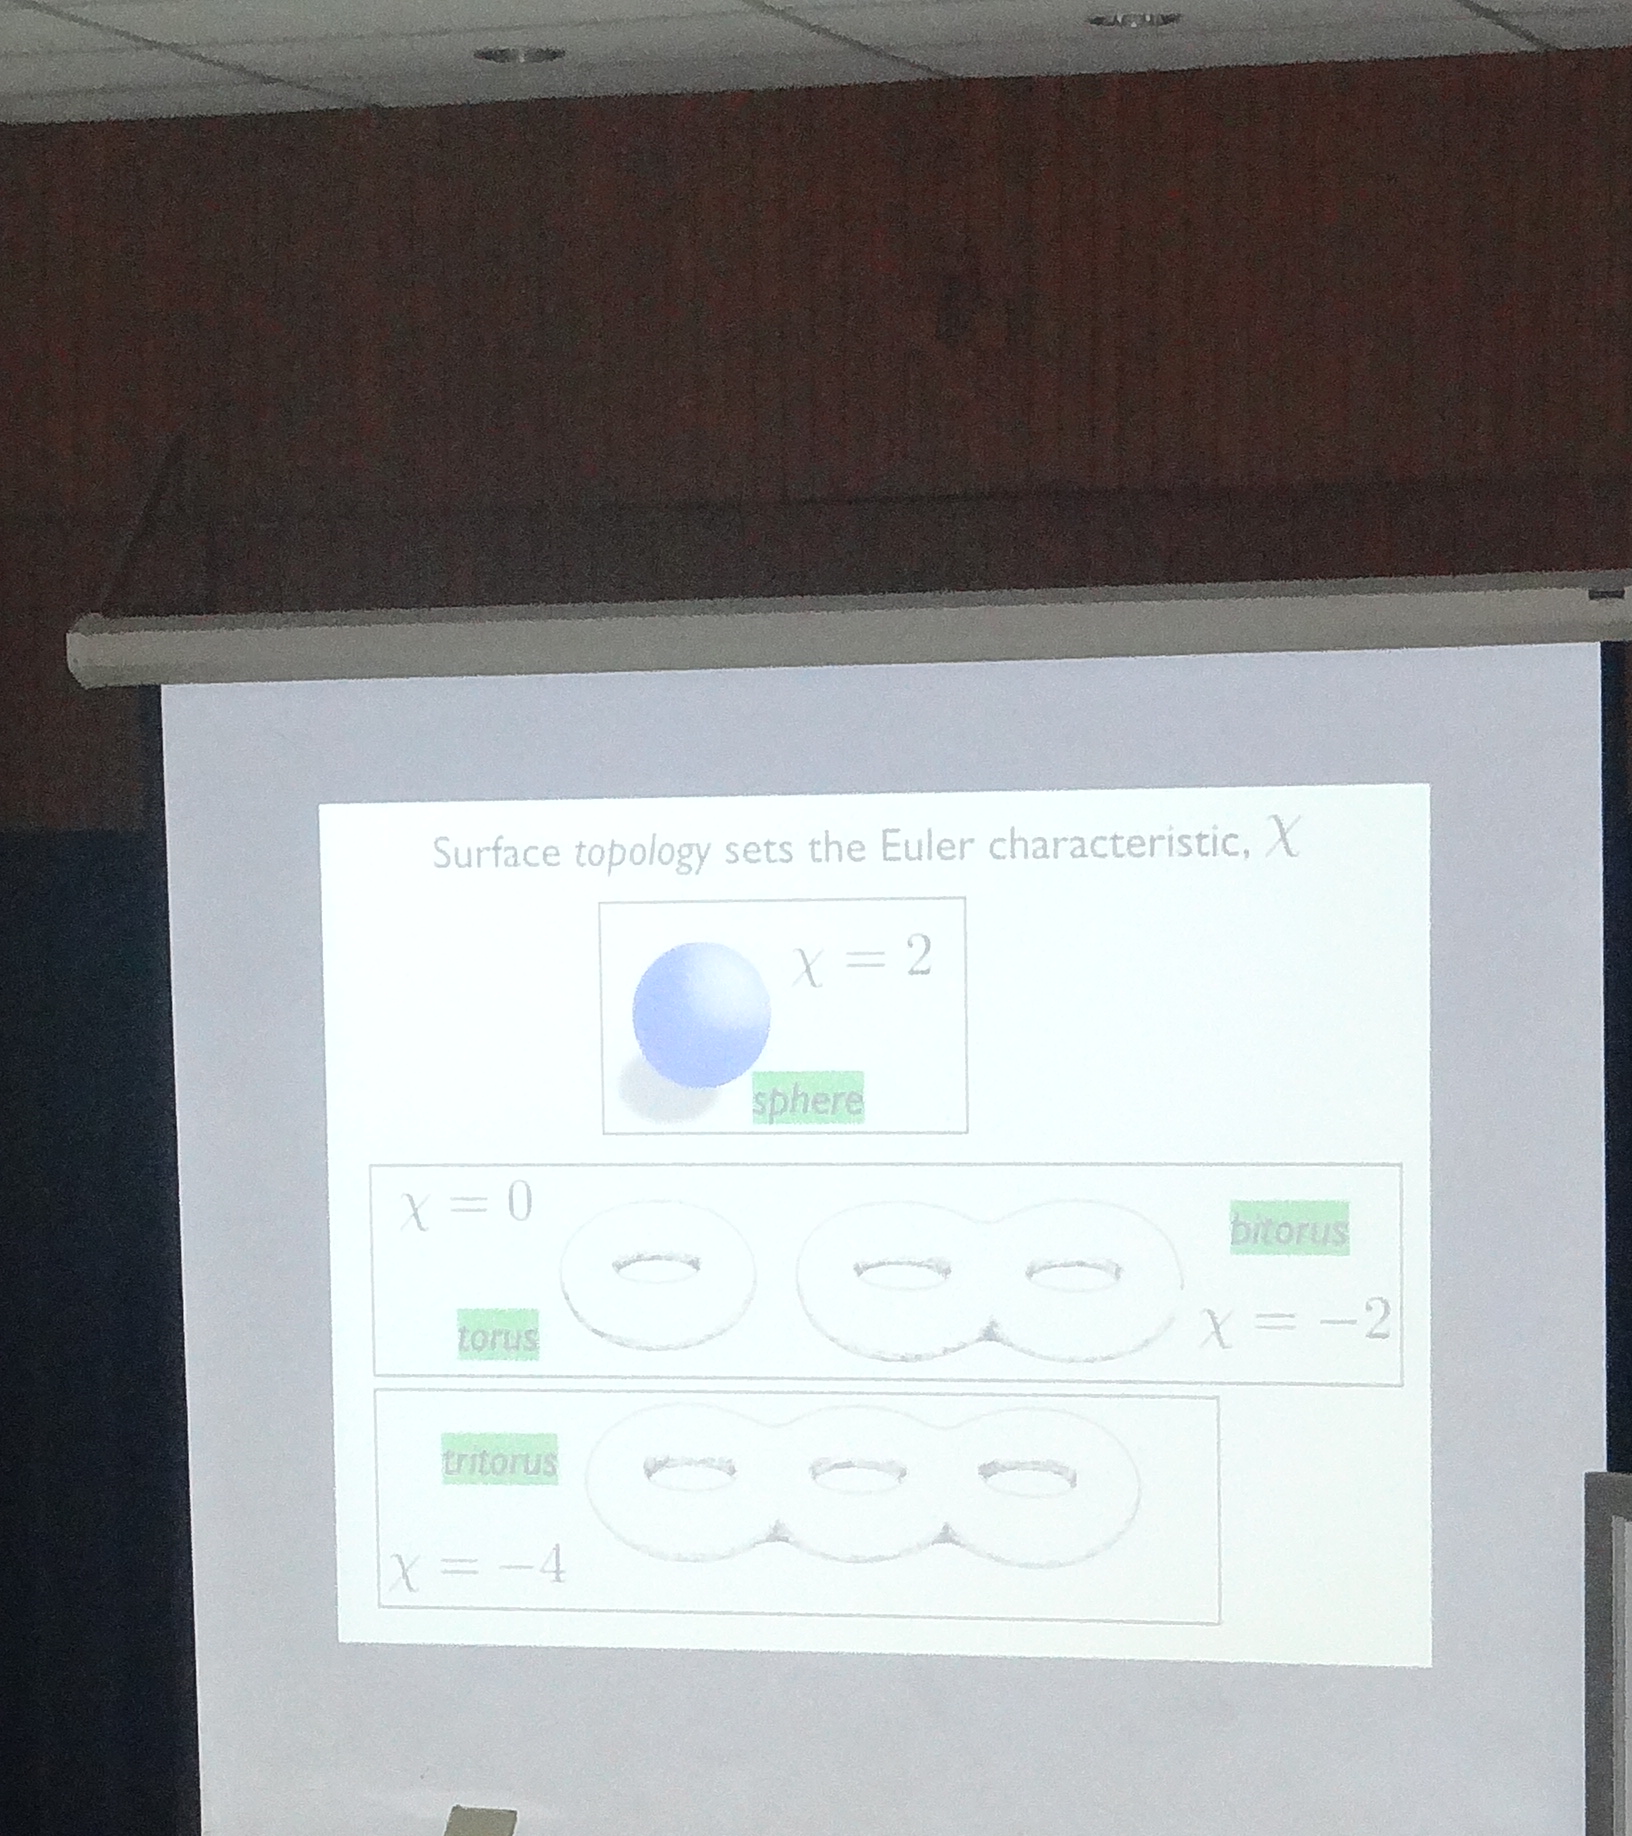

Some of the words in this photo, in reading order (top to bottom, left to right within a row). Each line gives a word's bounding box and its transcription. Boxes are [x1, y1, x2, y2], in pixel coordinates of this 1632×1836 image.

[433, 835, 562, 868] Surface
[574, 832, 712, 876] topology
[724, 837, 795, 865] sets
[809, 829, 867, 863] the
[880, 827, 975, 863] Euler
[988, 823, 1251, 863] characteristic,
[906, 932, 933, 976] 2
[752, 1081, 865, 1125] sphere
[507, 1178, 534, 1222] 0
[1230, 1210, 1349, 1246] bitorus
[457, 1322, 539, 1353] torus
[442, 1442, 559, 1477] tritorus
